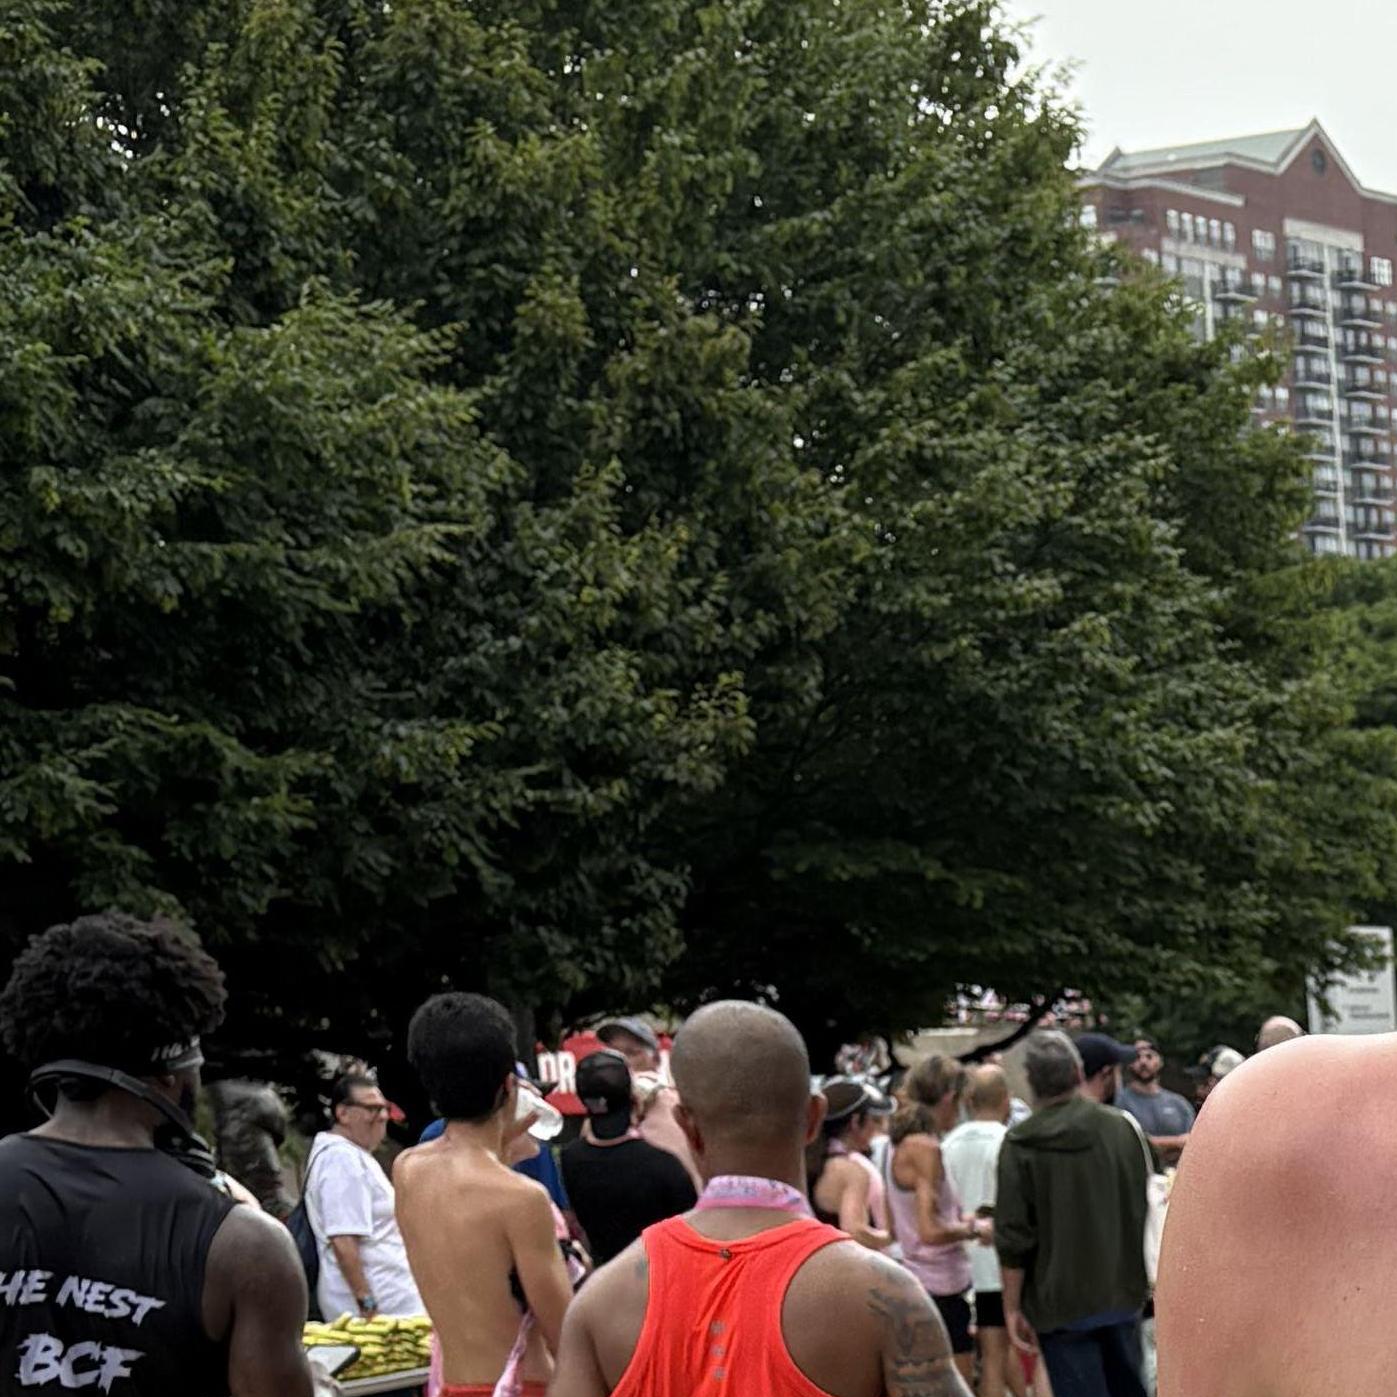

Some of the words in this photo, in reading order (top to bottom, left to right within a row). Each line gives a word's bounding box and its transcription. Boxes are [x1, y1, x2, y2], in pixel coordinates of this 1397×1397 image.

[0, 1268, 54, 1307] HE
[55, 1274, 167, 1328] NEST
[15, 1331, 147, 1397] BCF
